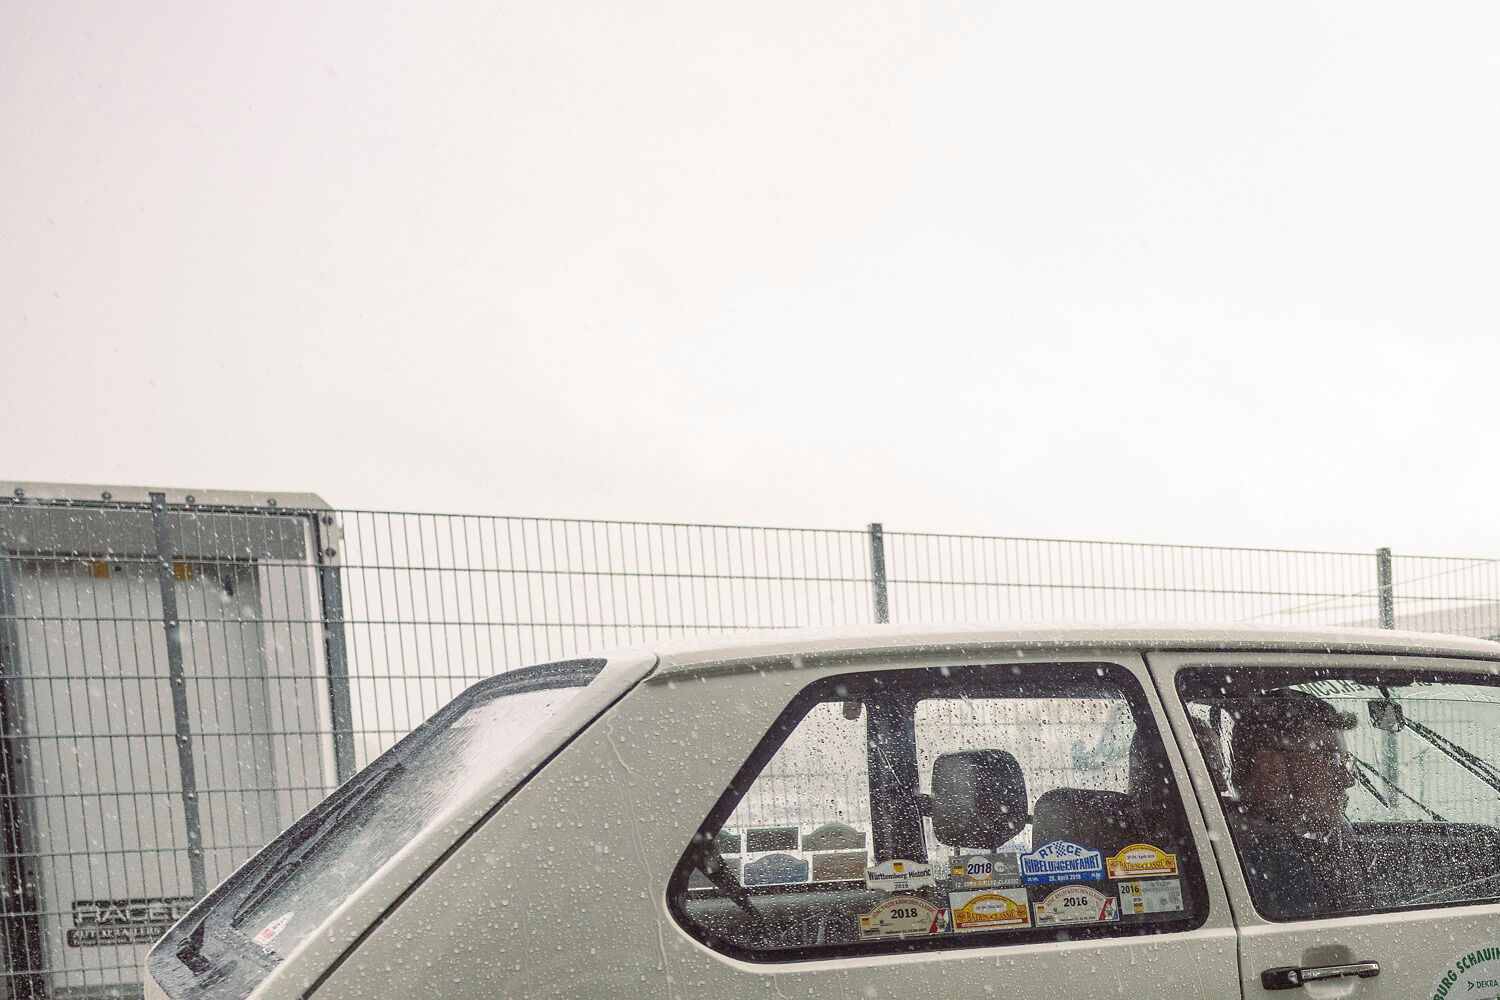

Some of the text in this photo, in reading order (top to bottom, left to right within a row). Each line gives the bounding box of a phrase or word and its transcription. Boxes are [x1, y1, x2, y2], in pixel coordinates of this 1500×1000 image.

[967, 862, 993, 875] 2018
[1024, 854, 1100, 873] NIBELUNGENFAHRT
[867, 868, 932, 881] Württemberg Historic
[1120, 885, 1140, 894] 2016
[1063, 896, 1088, 907] 2016
[890, 907, 918, 919] 2018
[1476, 979, 1498, 989] DEKRA
